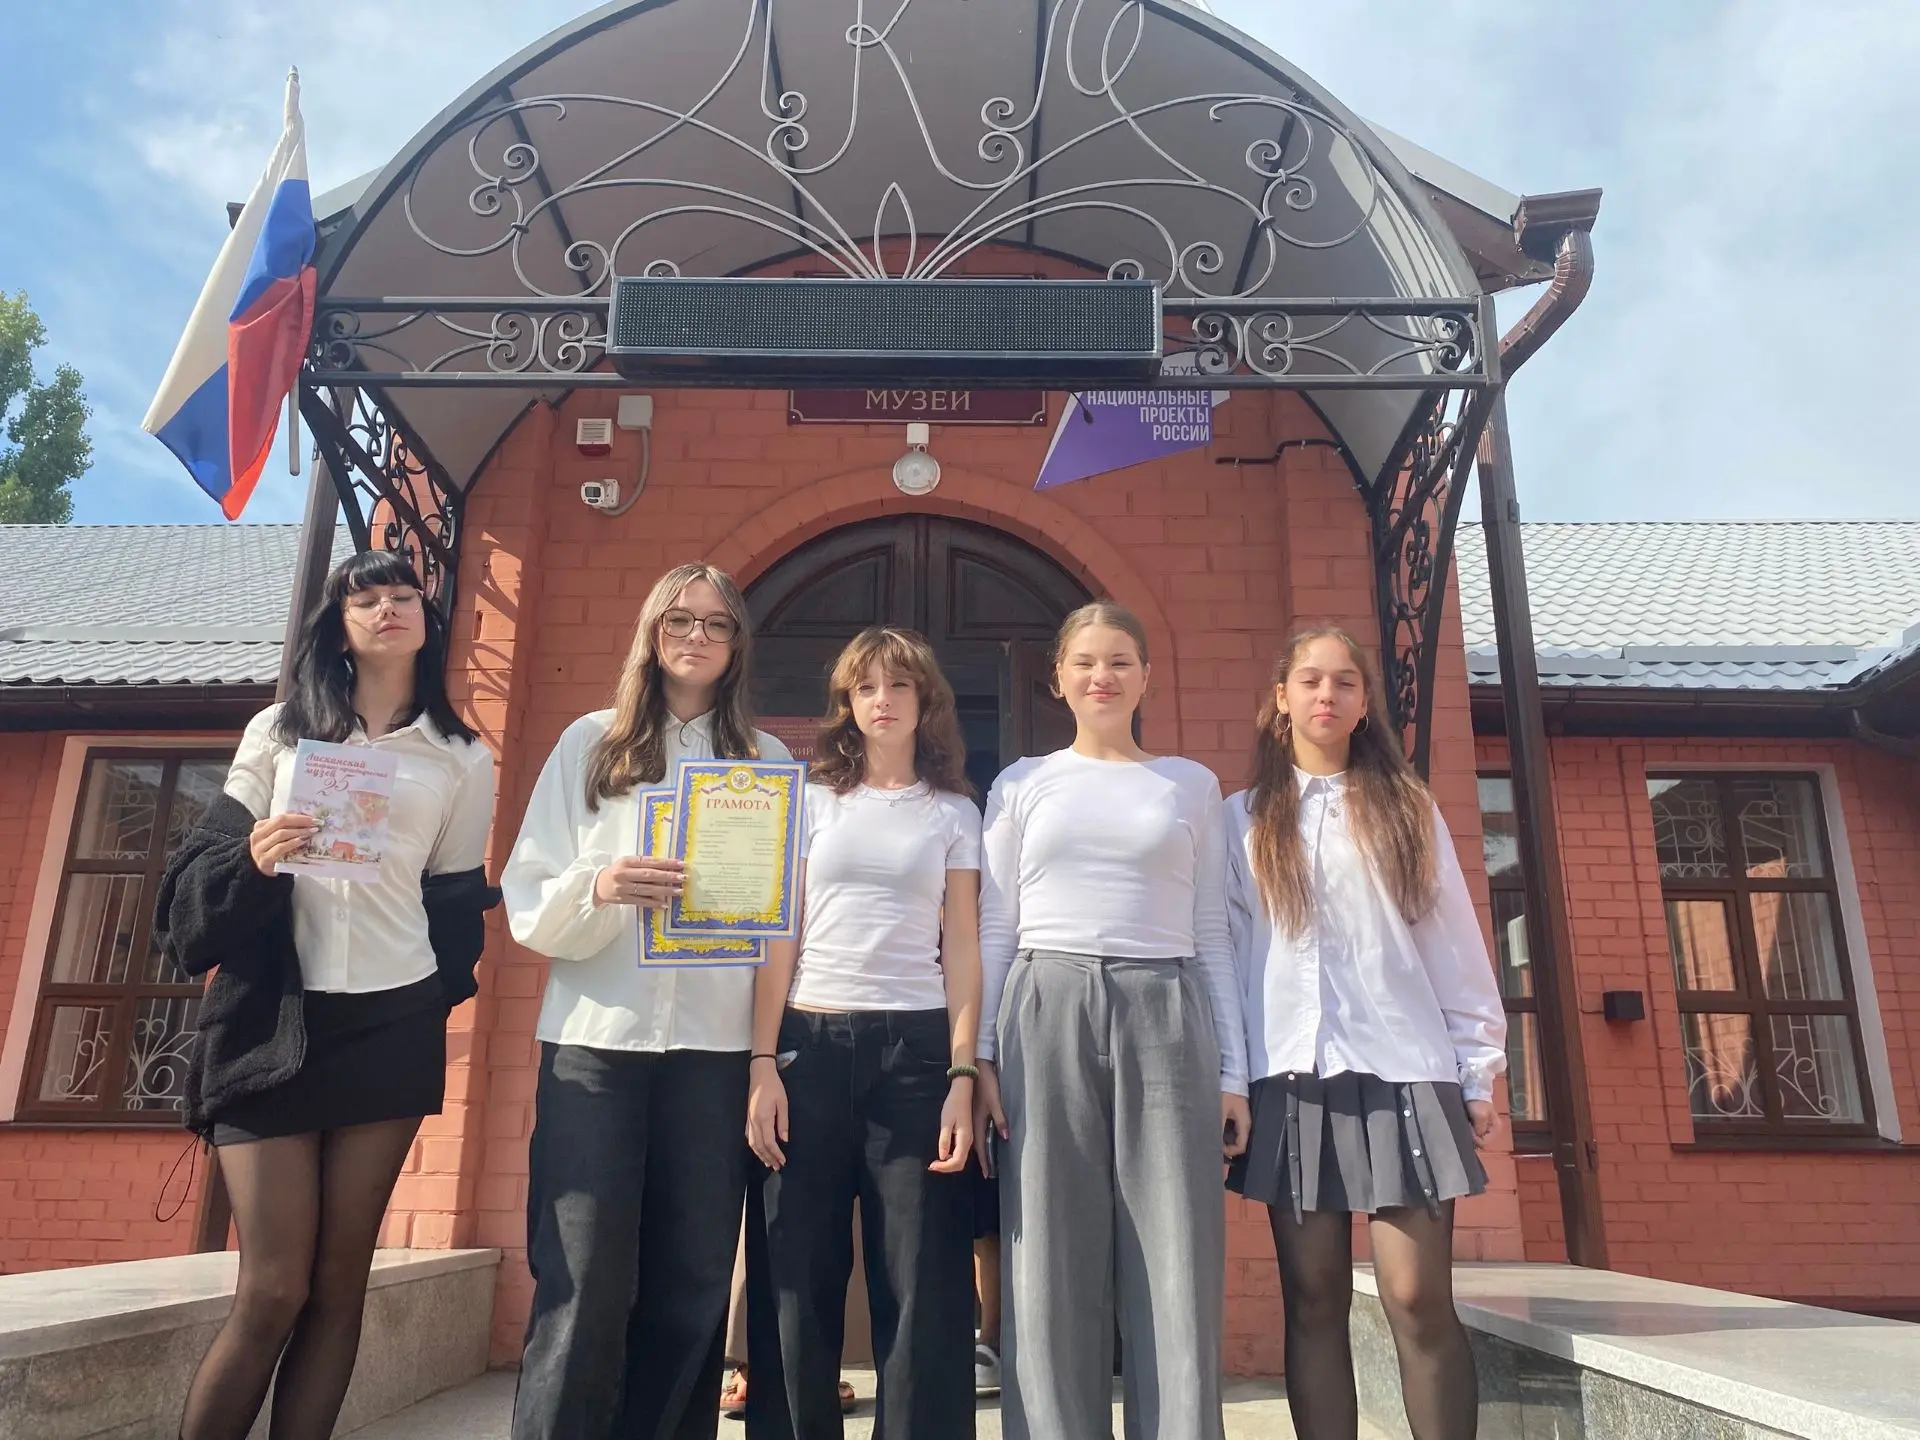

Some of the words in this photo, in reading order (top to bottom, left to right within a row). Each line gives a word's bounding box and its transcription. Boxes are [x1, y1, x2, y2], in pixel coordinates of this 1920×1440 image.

[1087, 390, 1209, 407] НАЦИОНАЛЬНЫЕ
[1140, 407, 1209, 423] ПРОЕКТЫ
[1153, 424, 1210, 441] РОССИИ
[316, 774, 354, 796] 25
[705, 798, 772, 811] ГРАМОТА
